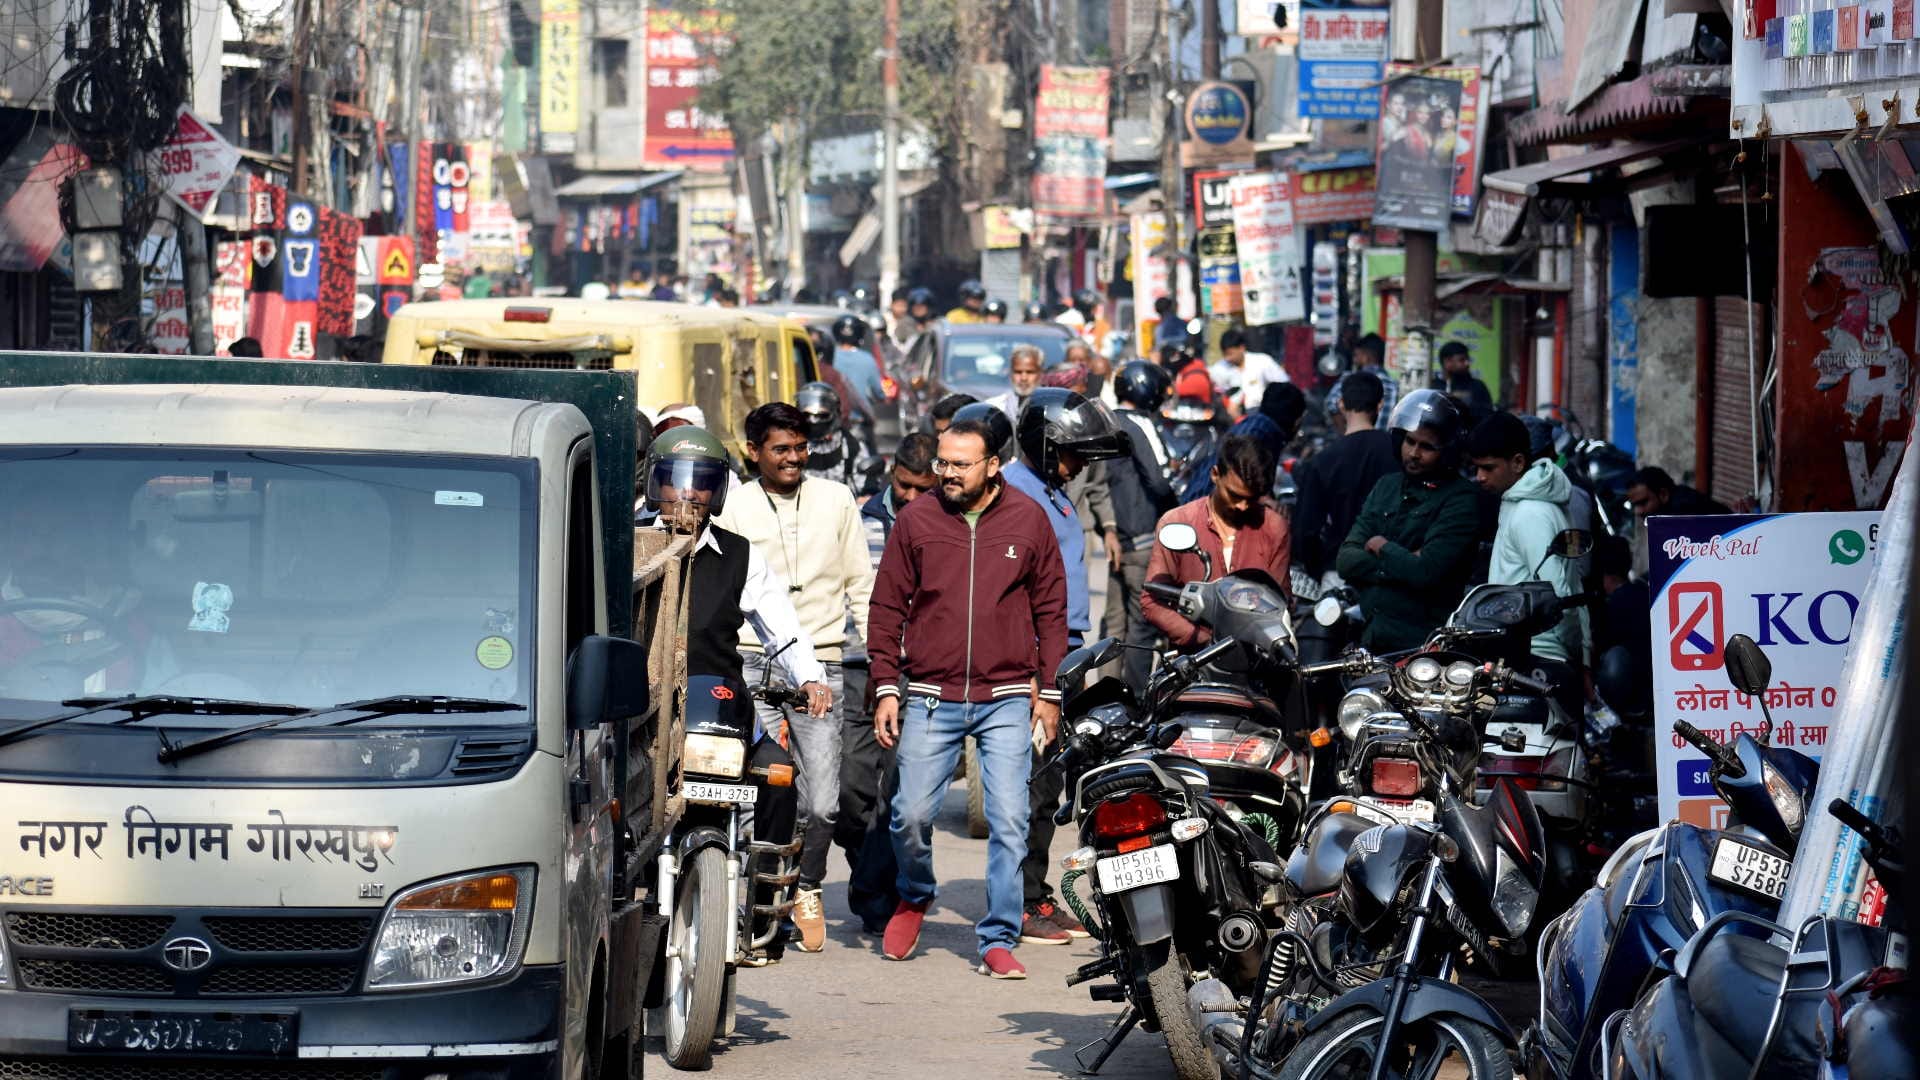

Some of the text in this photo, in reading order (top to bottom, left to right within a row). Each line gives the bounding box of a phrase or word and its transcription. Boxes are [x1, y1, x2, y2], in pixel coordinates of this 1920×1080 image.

[161, 149, 192, 176] 399
[1663, 534, 1762, 560] Vivek Pal
[1675, 683, 1729, 711] लोन
[1776, 720, 1795, 746] भी
[1693, 770, 1711, 784] SA
[18, 805, 400, 873] नगर निगम गोरखपुर
[1112, 850, 1161, 872] UP56A
[1736, 845, 1792, 880] UP53D
[1114, 865, 1165, 889] M9396
[1731, 865, 1786, 899] S7580
